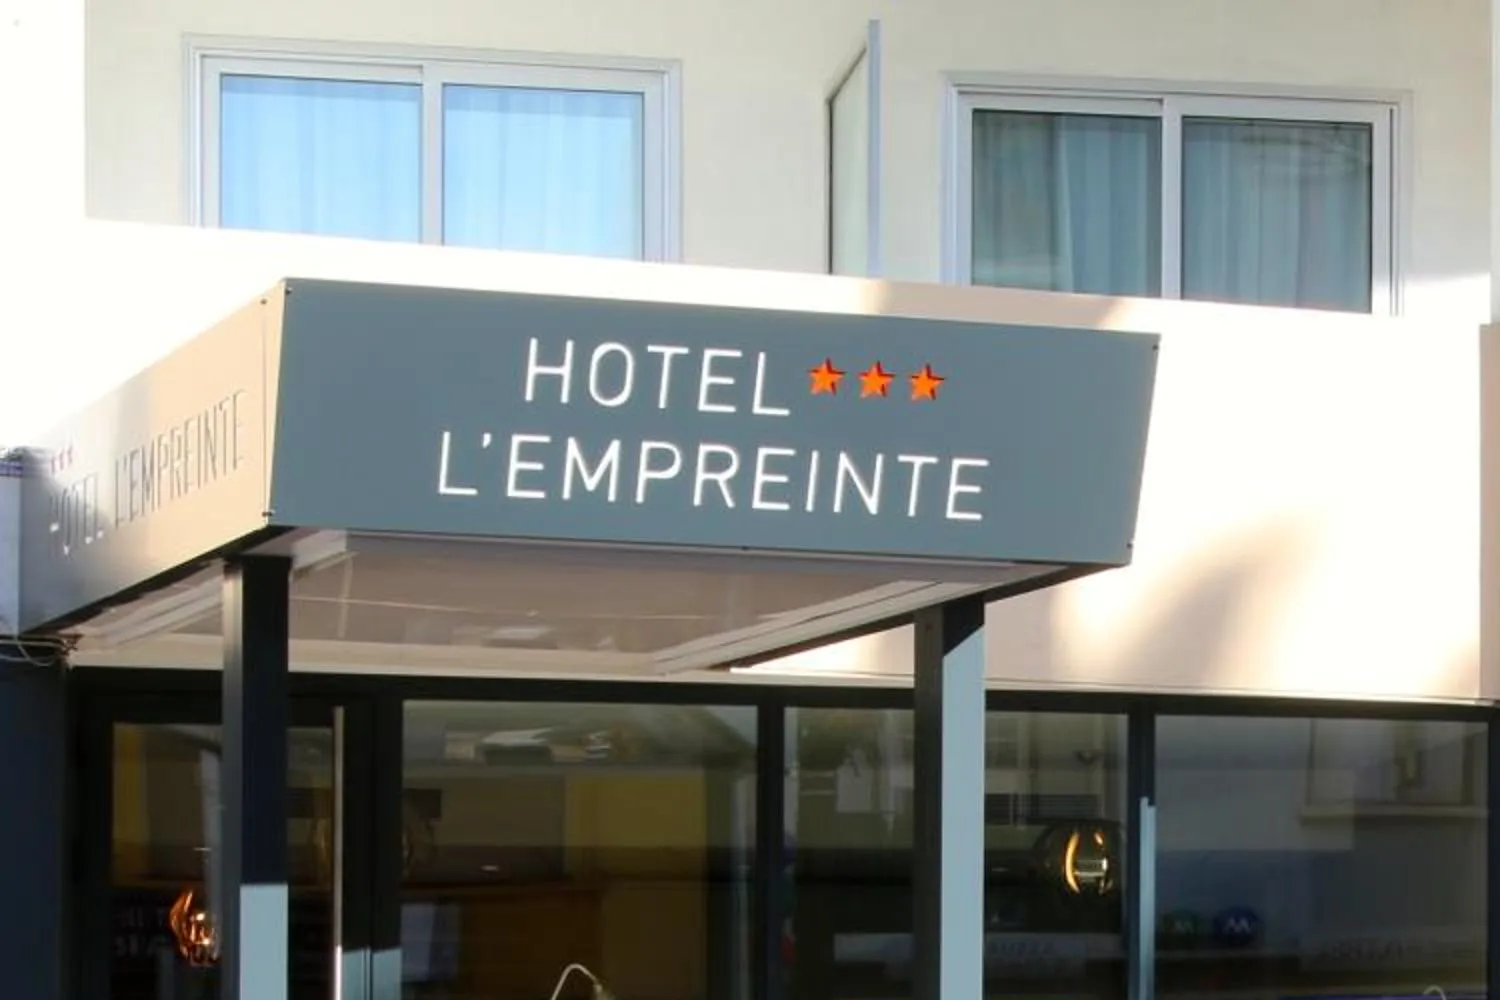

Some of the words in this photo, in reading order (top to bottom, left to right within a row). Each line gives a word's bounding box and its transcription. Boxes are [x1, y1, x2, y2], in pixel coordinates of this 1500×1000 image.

[524, 337, 791, 417] HOTEL
[114, 391, 246, 528] L'EMPREINTE
[437, 431, 991, 521] L'EMPREINTE
